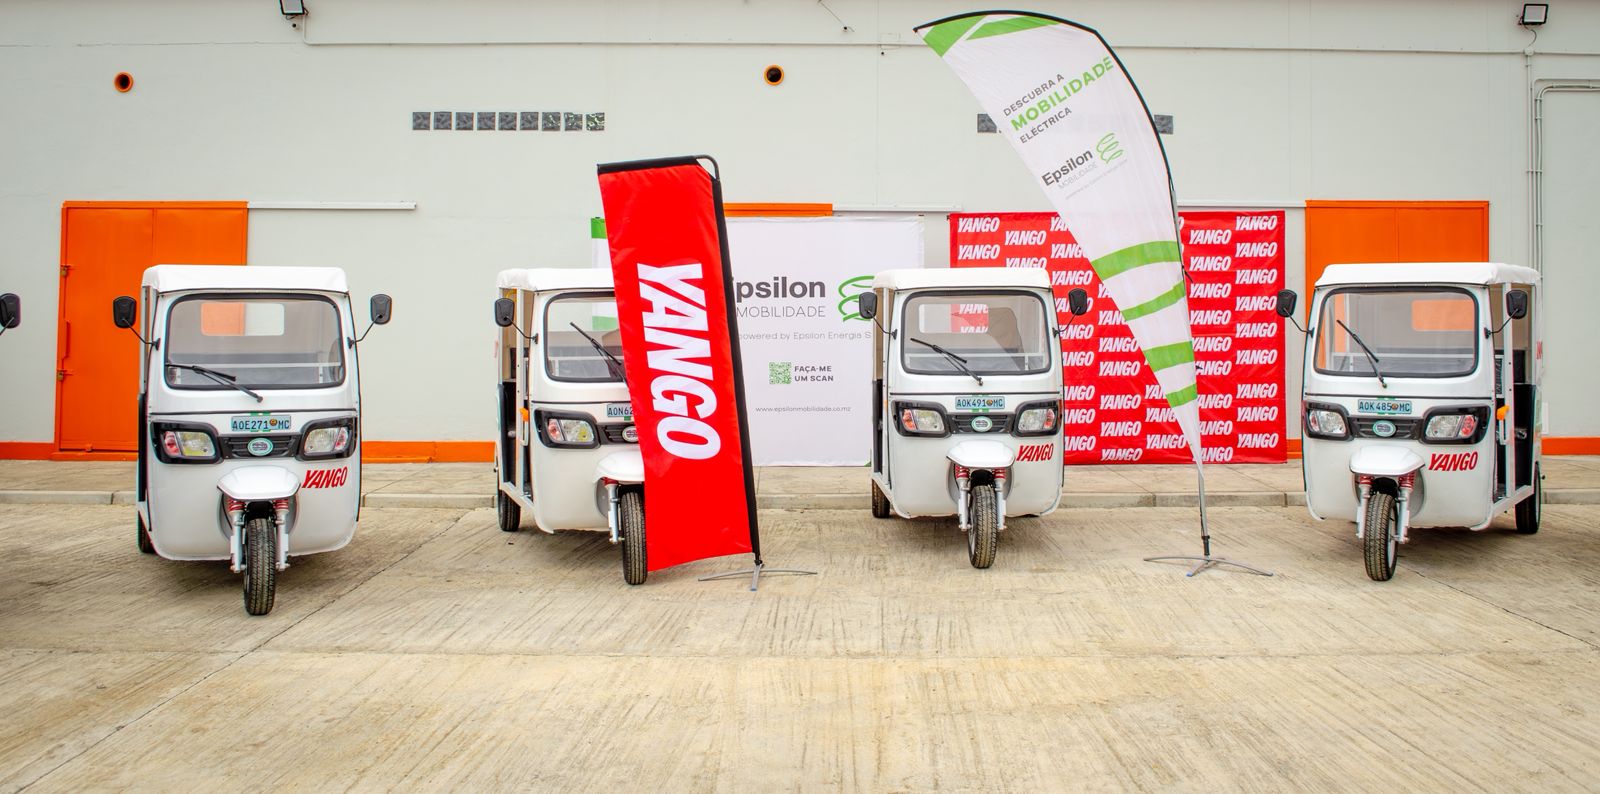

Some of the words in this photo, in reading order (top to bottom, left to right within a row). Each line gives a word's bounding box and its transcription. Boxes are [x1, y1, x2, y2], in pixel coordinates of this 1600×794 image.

[1003, 79, 1055, 117] DESCUBRA
[1056, 73, 1065, 83] A
[1011, 56, 1114, 131] MOBILIDADE
[1041, 150, 1094, 187] Epsilon
[957, 217, 1001, 233] YANGO
[1235, 215, 1277, 231] YANGO
[1004, 230, 1047, 246] YANGO
[1189, 229, 1232, 245] YANGO
[957, 244, 1001, 260] YANGO
[1235, 242, 1277, 258] YANGO
[1005, 257, 1048, 268] YANGO
[1189, 256, 1232, 271] YANGO
[1051, 270, 1094, 286] YANGO
[1235, 269, 1277, 285] YANGO
[736, 276, 826, 304] psilon
[1189, 283, 1232, 298] YANGO
[1235, 296, 1277, 311] YANGO
[736, 306, 826, 318] MOBILIDADE
[1189, 310, 1232, 325] YANGO
[740, 332, 778, 341] owered
[780, 332, 791, 342] by
[793, 331, 826, 342] Epsilon
[828, 331, 862, 341] Energia
[1235, 322, 1277, 338] YANGO
[636, 262, 721, 460] YANGO
[1235, 349, 1278, 365] YANGO
[1099, 361, 1141, 377] YANGO
[1236, 383, 1278, 399] YANGO
[993, 398, 1003, 408] MC
[1099, 394, 1142, 410] YANGO
[1399, 403, 1410, 412] MC
[1236, 406, 1279, 422] YANGO
[278, 420, 290, 430] MC
[1100, 421, 1142, 437] YANGO
[1199, 420, 1233, 436] ANGO
[1146, 434, 1187, 449] YANGO
[1237, 433, 1279, 448] YANGO
[1016, 443, 1054, 462] YANGO
[1101, 448, 1143, 462] YANGO
[1428, 451, 1479, 472] YANGO
[302, 466, 348, 489] YANGO
